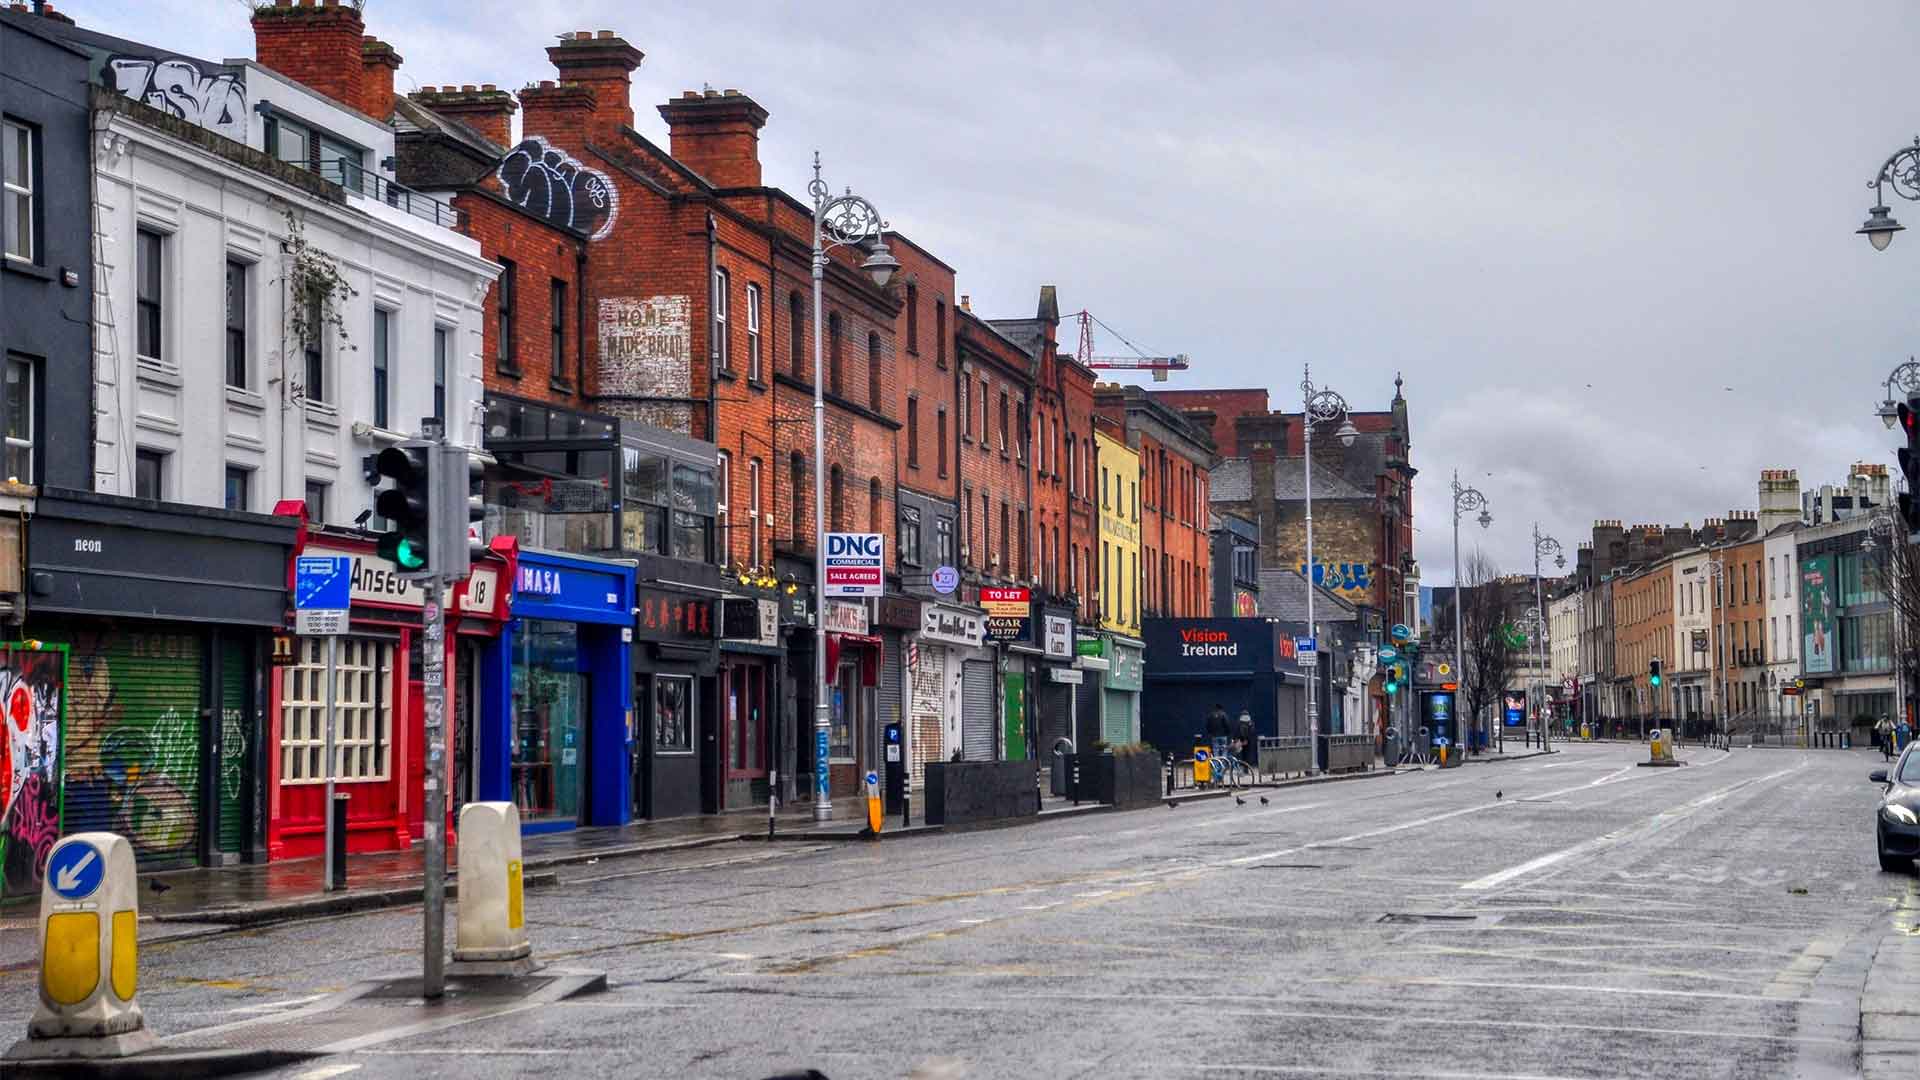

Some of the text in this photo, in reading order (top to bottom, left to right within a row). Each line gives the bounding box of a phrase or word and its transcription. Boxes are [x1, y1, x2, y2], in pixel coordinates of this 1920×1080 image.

[618, 309, 673, 327] HOME
[75, 538, 102, 553] neon
[828, 535, 880, 556] DNG
[350, 557, 407, 596] Anseo
[524, 567, 561, 595] MASA
[849, 573, 878, 581] AGREED
[474, 581, 486, 604] 18
[988, 591, 1022, 600] TO LET
[988, 618, 1022, 628] AGAR
[1181, 629, 1229, 643] Vision
[1182, 643, 1238, 657] Ireland
